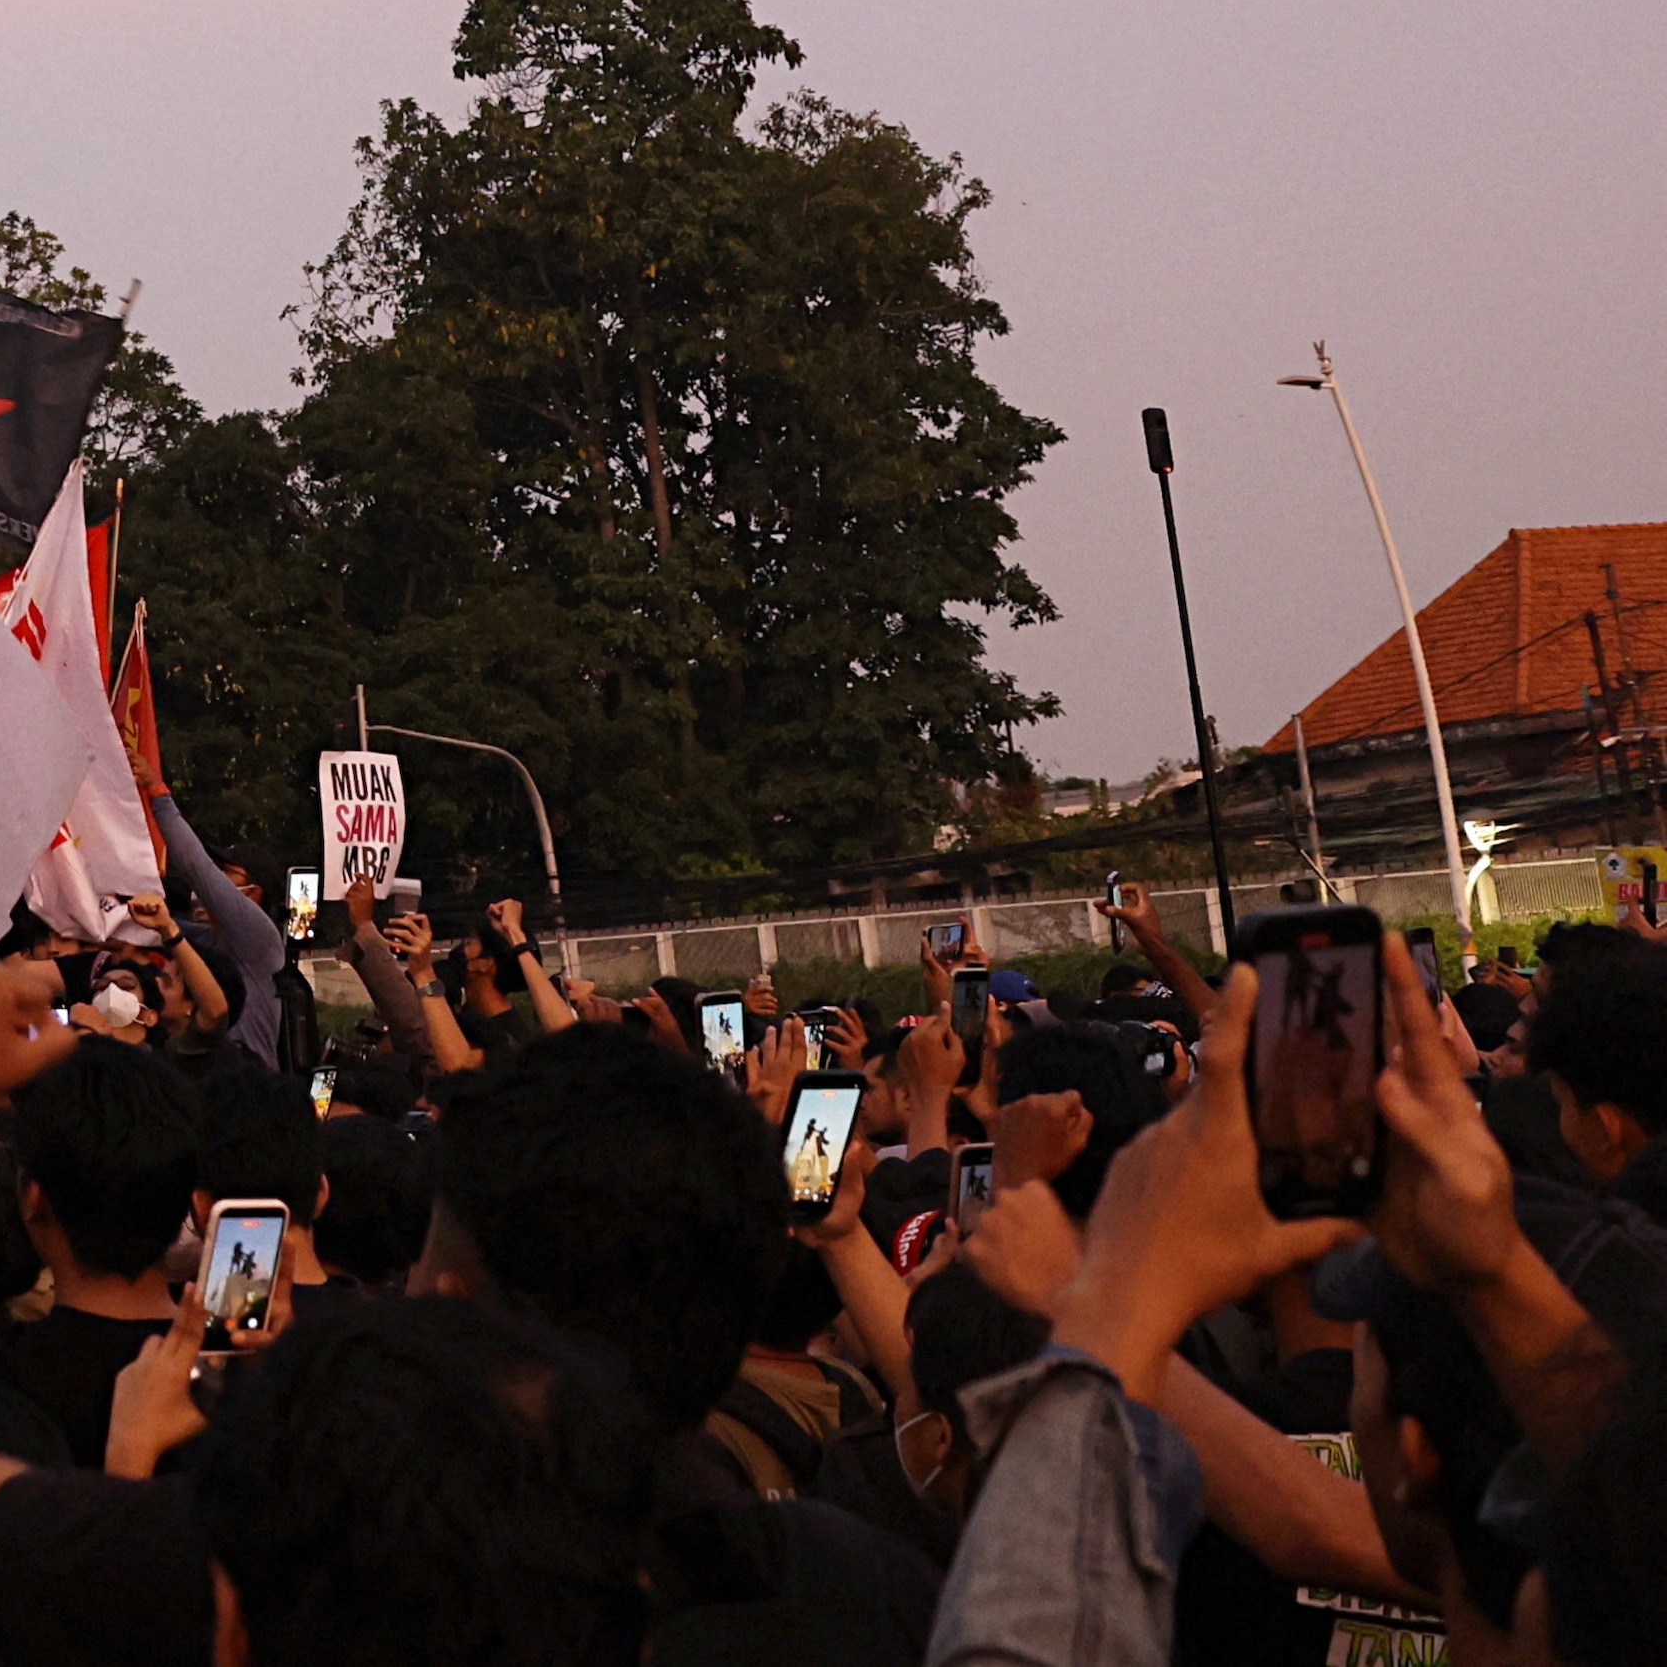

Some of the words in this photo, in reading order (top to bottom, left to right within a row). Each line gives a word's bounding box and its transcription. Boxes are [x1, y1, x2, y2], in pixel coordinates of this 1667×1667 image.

[330, 763, 398, 803] MUAK
[335, 803, 398, 845] SAMA
[342, 845, 391, 885] MBG
